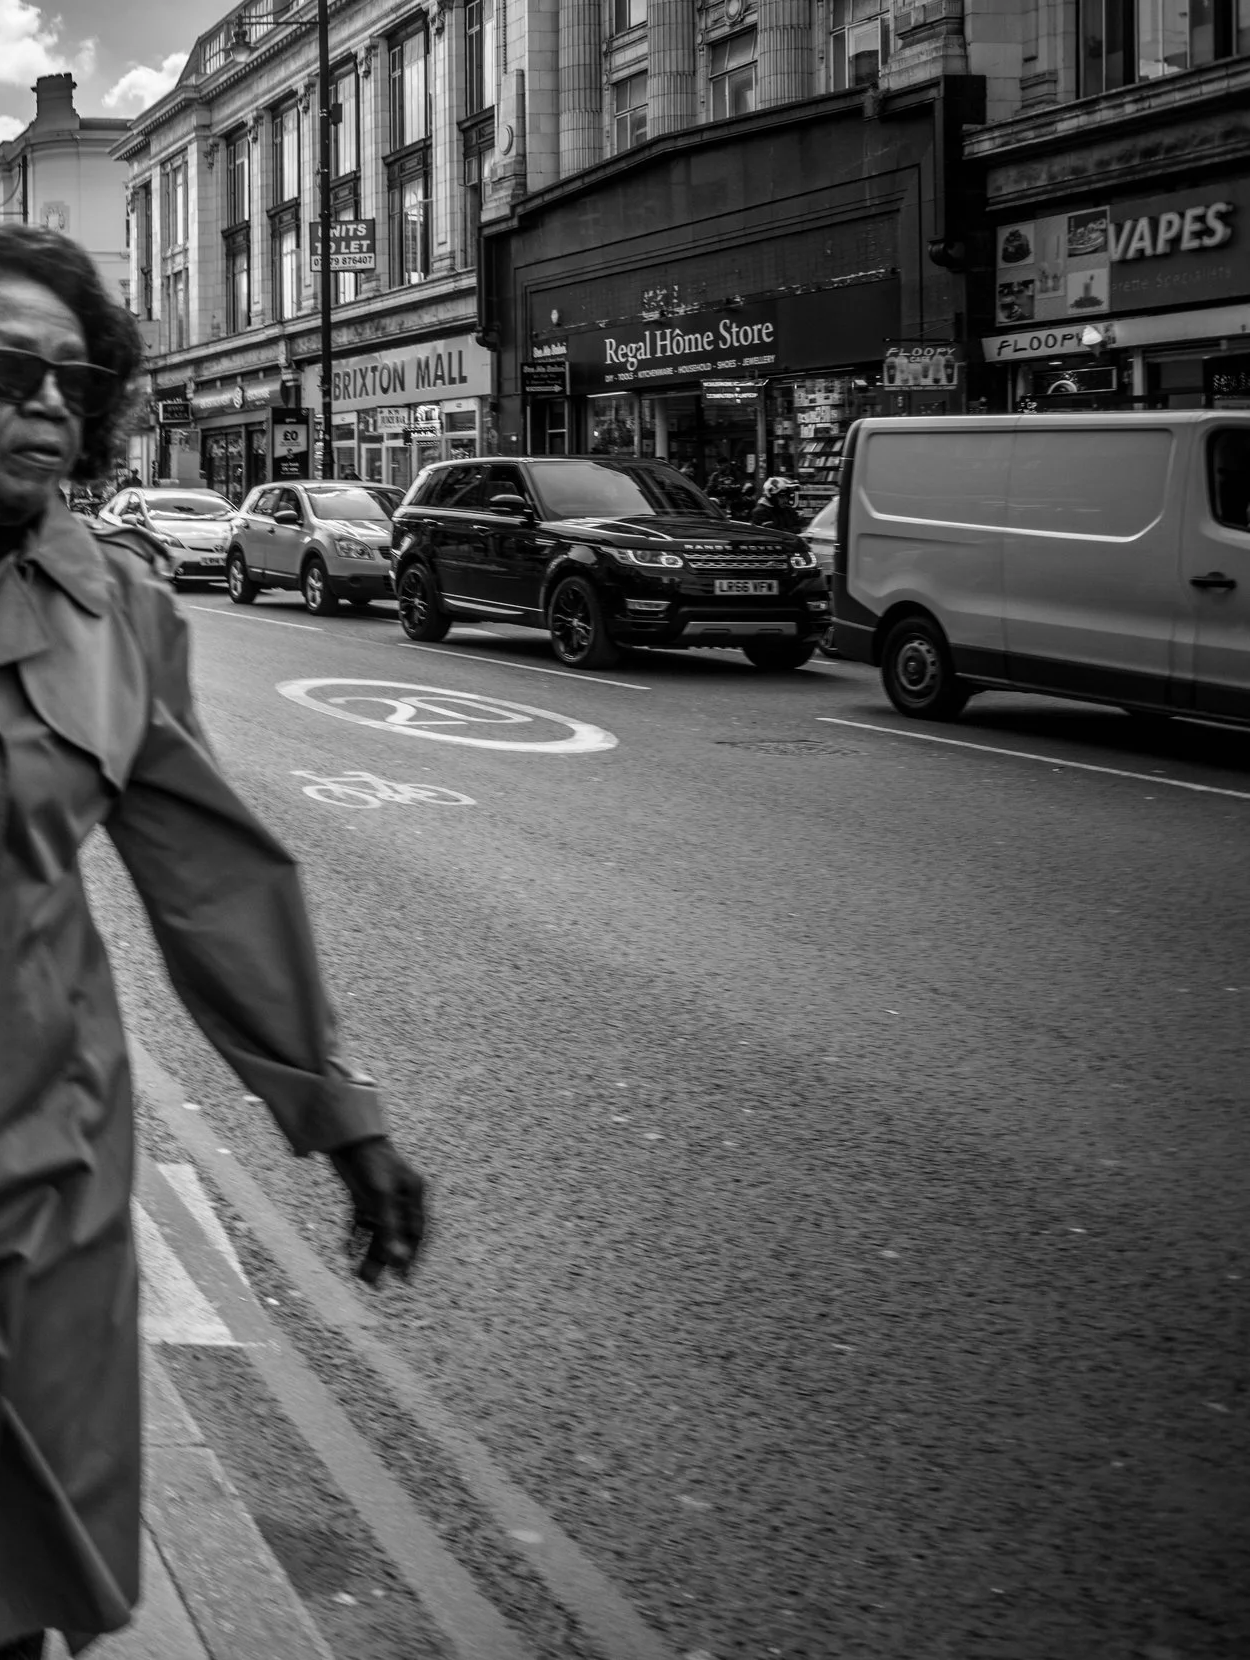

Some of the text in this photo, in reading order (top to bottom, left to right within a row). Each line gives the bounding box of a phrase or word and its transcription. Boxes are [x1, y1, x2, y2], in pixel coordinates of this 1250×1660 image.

[1108, 202, 1234, 262] VAPES
[341, 240, 370, 253] LET
[341, 255, 373, 265] 876407
[604, 331, 652, 371] Regal
[718, 319, 775, 349] Store
[885, 347, 957, 357] FLOOPY
[333, 349, 469, 401] BRIXTON MALL
[637, 367, 674, 379] KITCHENWARE
[677, 362, 712, 374] HOUSEHOLD
[716, 359, 737, 369] SHOES
[741, 354, 776, 367] JEWELLERY
[282, 430, 299, 442] £0
[327, 696, 534, 726] 20
